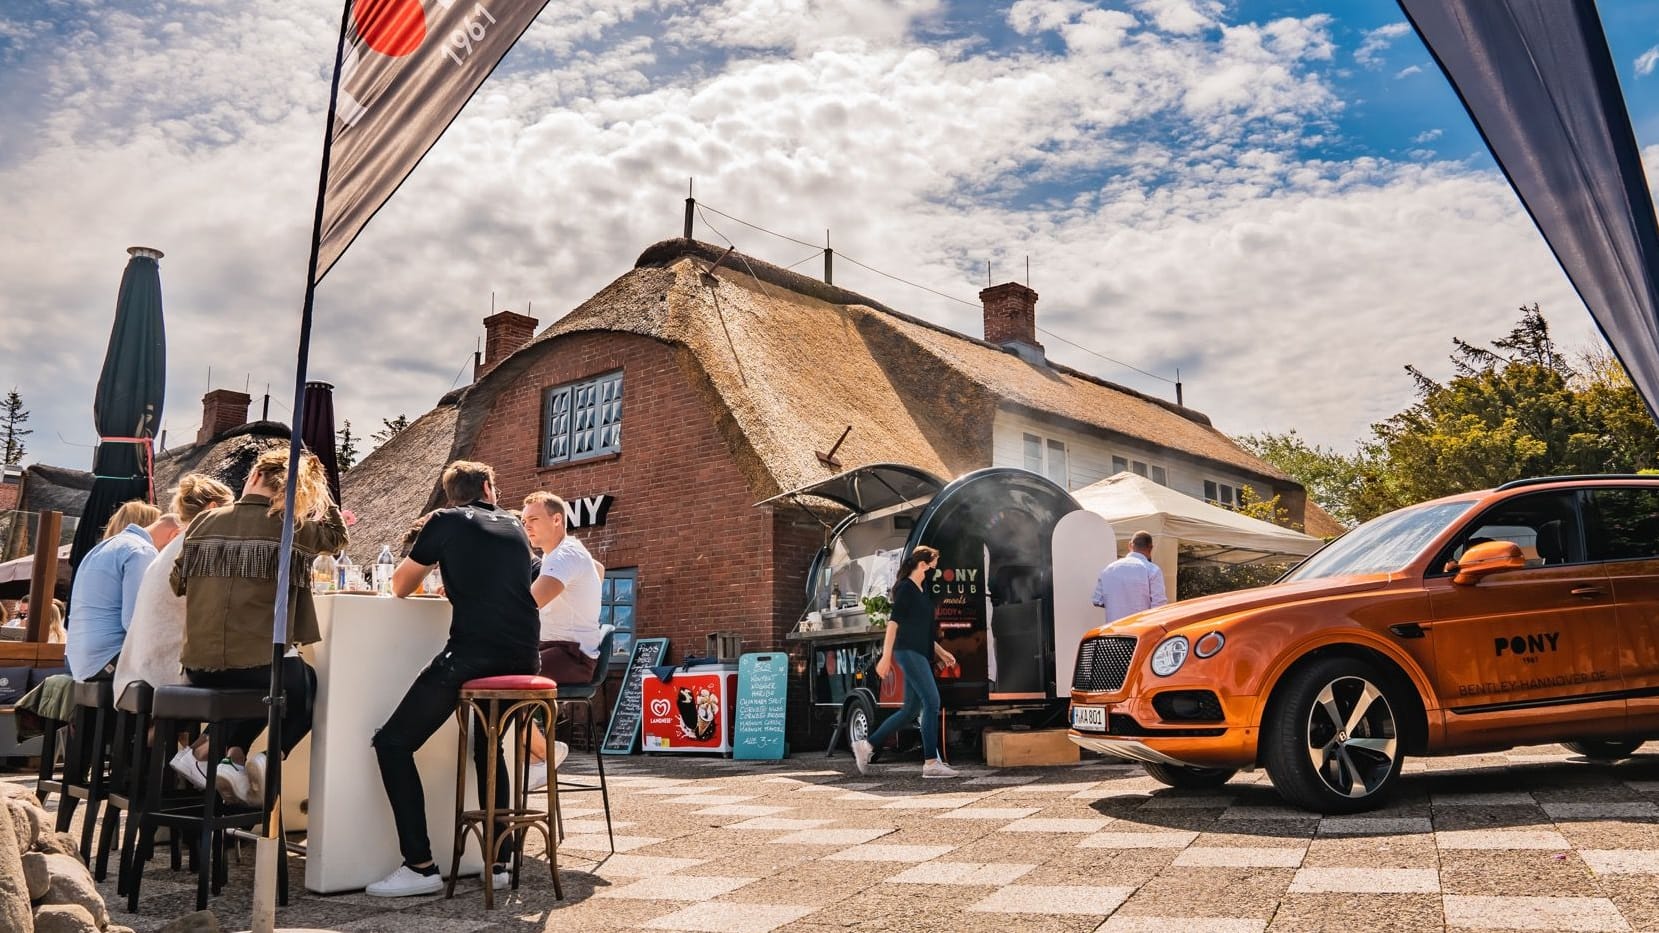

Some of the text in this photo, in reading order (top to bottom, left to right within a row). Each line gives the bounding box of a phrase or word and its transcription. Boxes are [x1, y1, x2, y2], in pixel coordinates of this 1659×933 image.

[440, 2, 497, 67] 1961
[932, 568, 978, 582] PONY
[932, 583, 977, 594] CLUB
[943, 595, 966, 604] meets
[1494, 632, 1560, 656] PONY
[815, 647, 857, 675] PONY
[1089, 710, 1102, 724] 801
